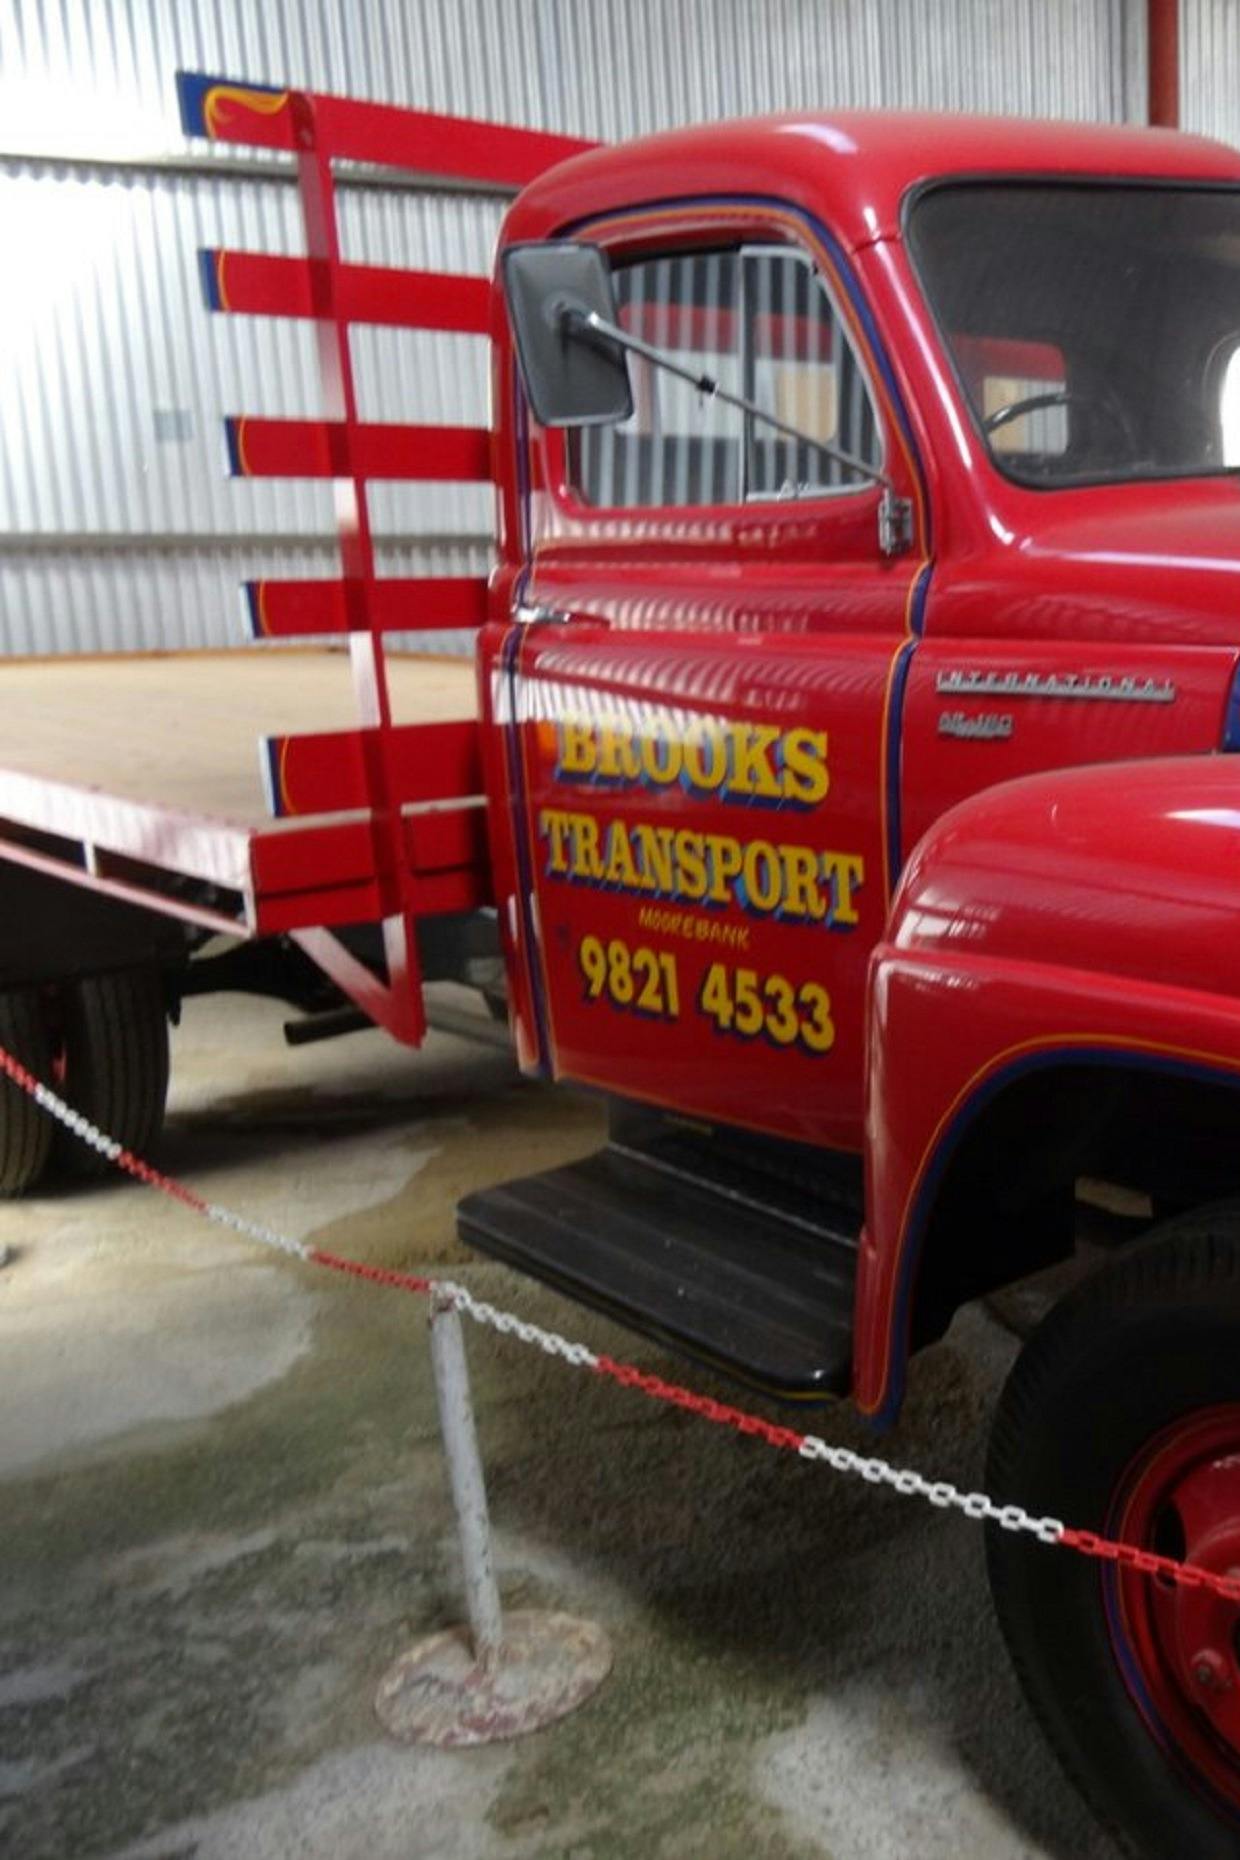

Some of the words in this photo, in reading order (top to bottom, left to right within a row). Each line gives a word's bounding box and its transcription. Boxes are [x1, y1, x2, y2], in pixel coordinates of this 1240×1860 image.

[936, 671, 1175, 702] INTERNATIONAL
[555, 708, 831, 812] BROOKS
[539, 808, 864, 932] TRANSPORT
[638, 905, 750, 950] MOOREBANK
[578, 935, 681, 1023] 9821
[698, 961, 836, 1056] 4533
